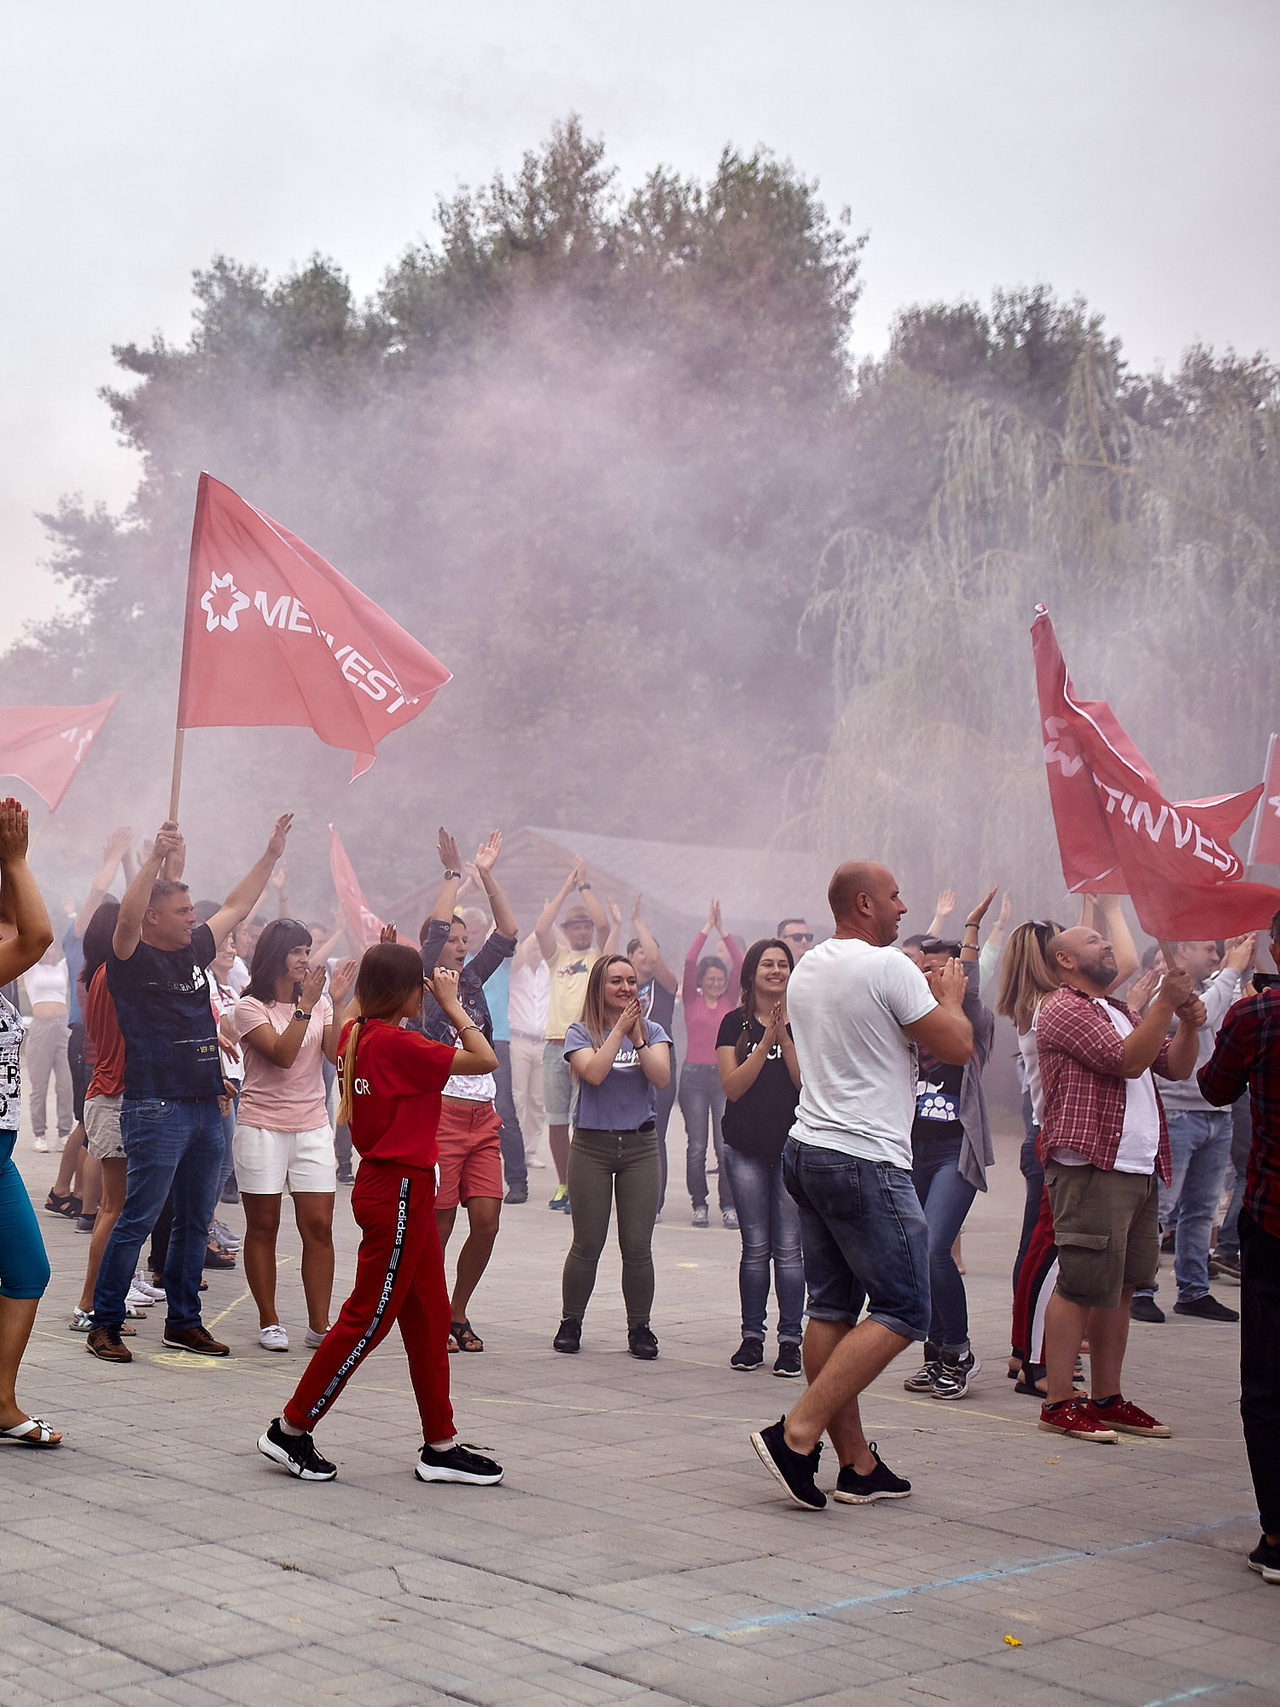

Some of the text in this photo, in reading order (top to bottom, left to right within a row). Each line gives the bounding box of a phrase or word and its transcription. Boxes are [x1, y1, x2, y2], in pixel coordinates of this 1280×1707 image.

[254, 590, 419, 714] MEEST
[395, 1200, 407, 1245] adidas
[375, 1272, 394, 1315] adidas
[337, 1338, 367, 1376] adidas
